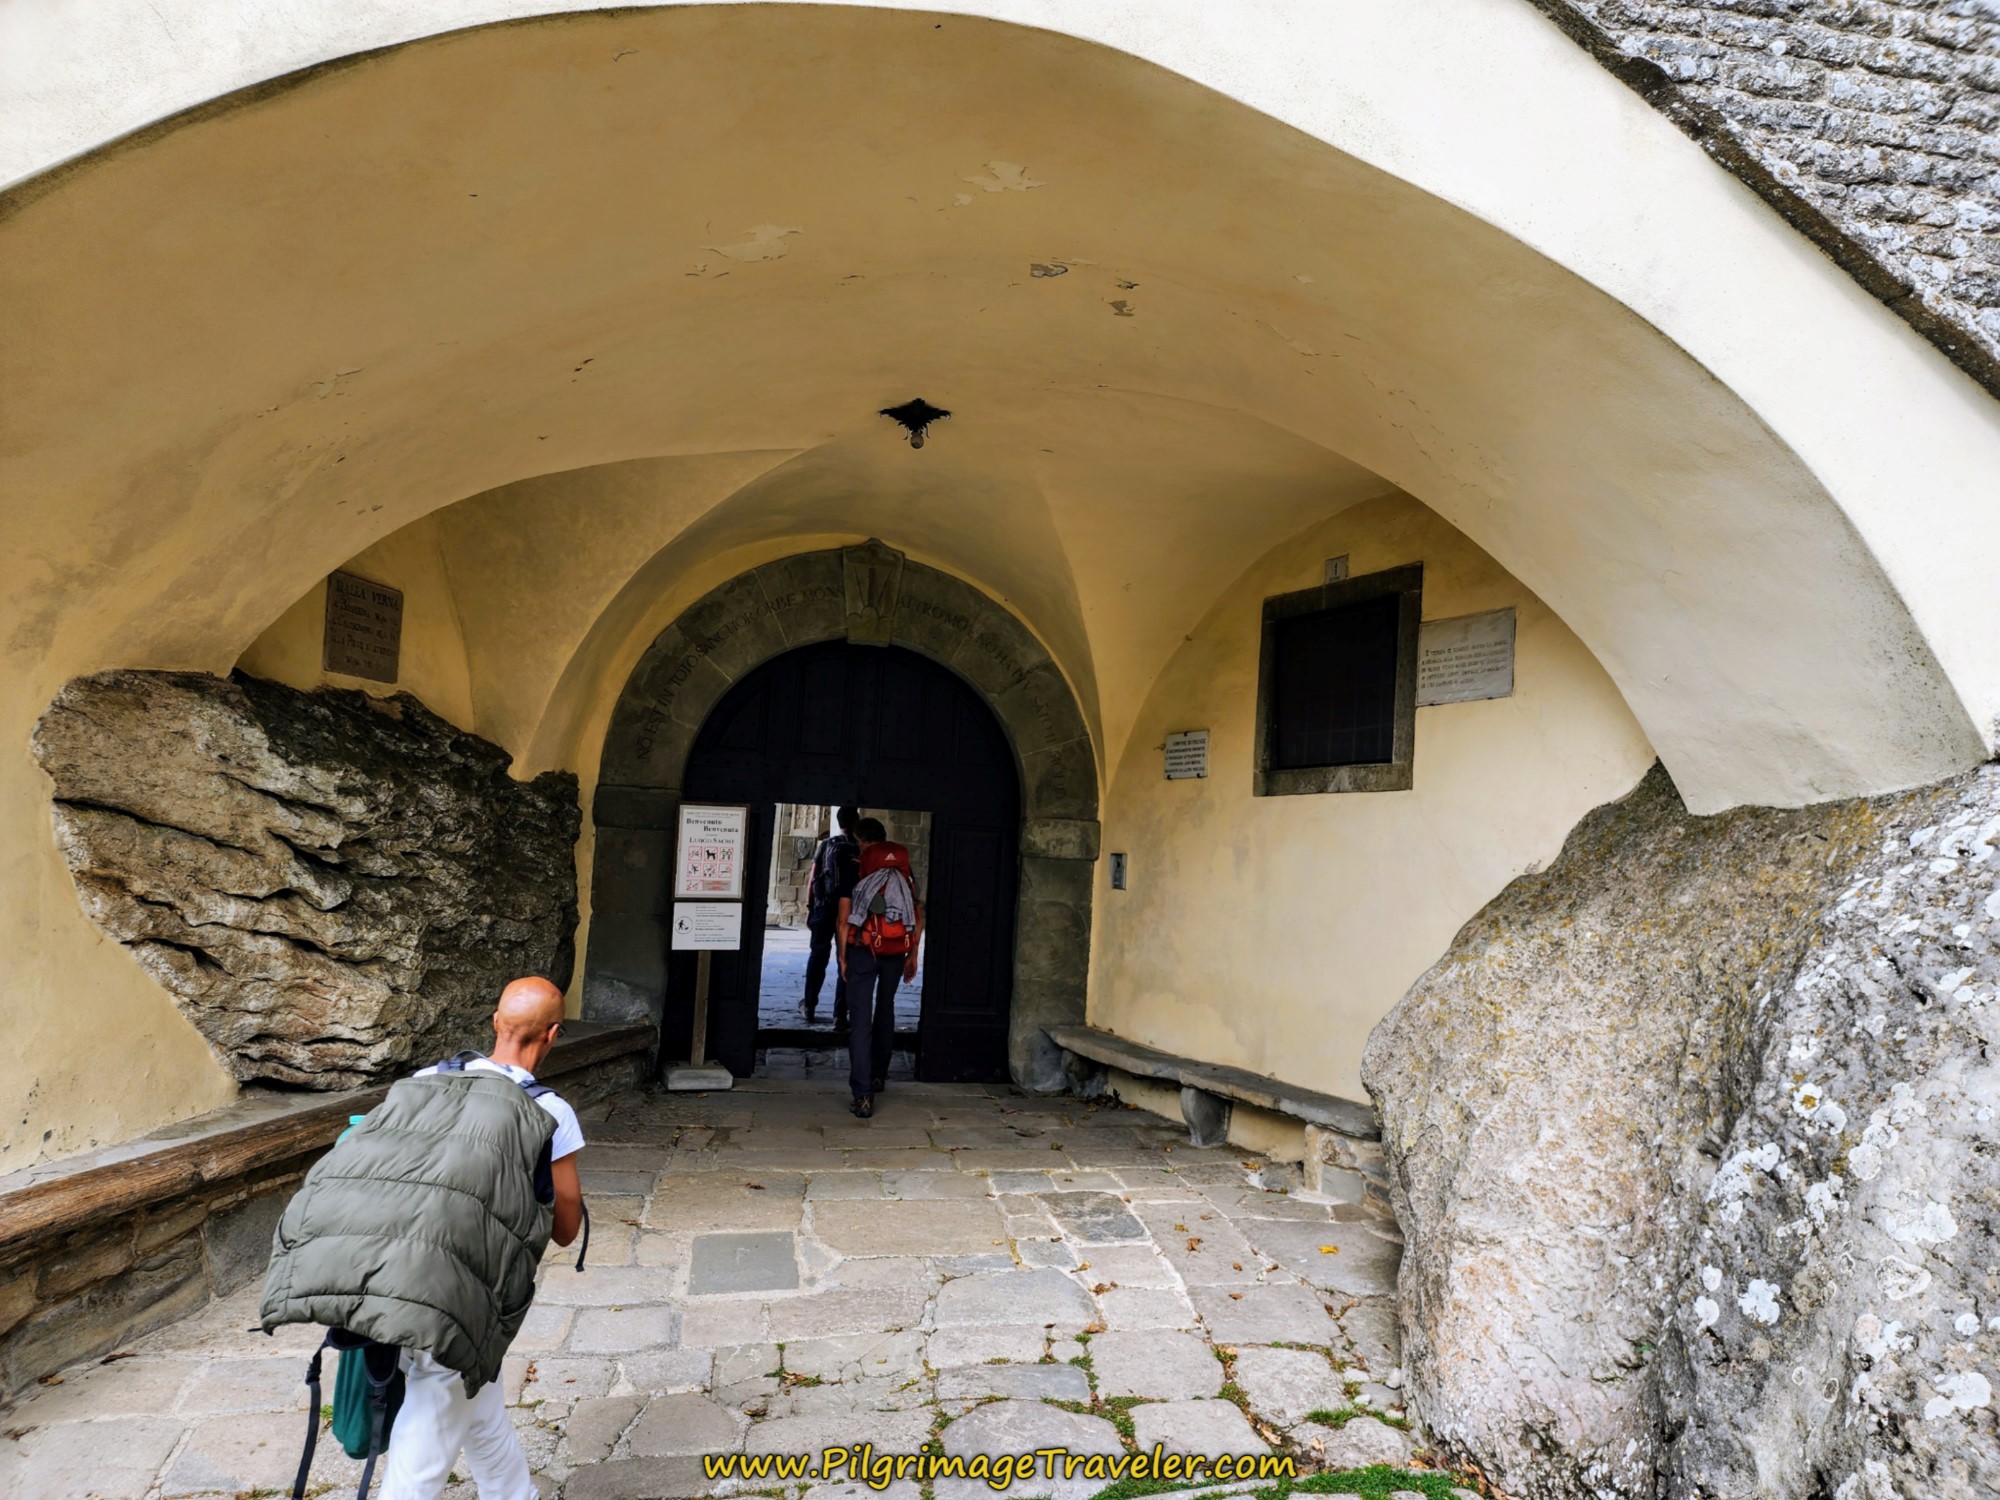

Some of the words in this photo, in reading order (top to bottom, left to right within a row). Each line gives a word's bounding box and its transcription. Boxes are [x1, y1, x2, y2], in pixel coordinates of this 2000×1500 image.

[656, 687, 675, 707] IN
[667, 655, 699, 687] TOTO
[756, 593, 796, 617] ORBE
